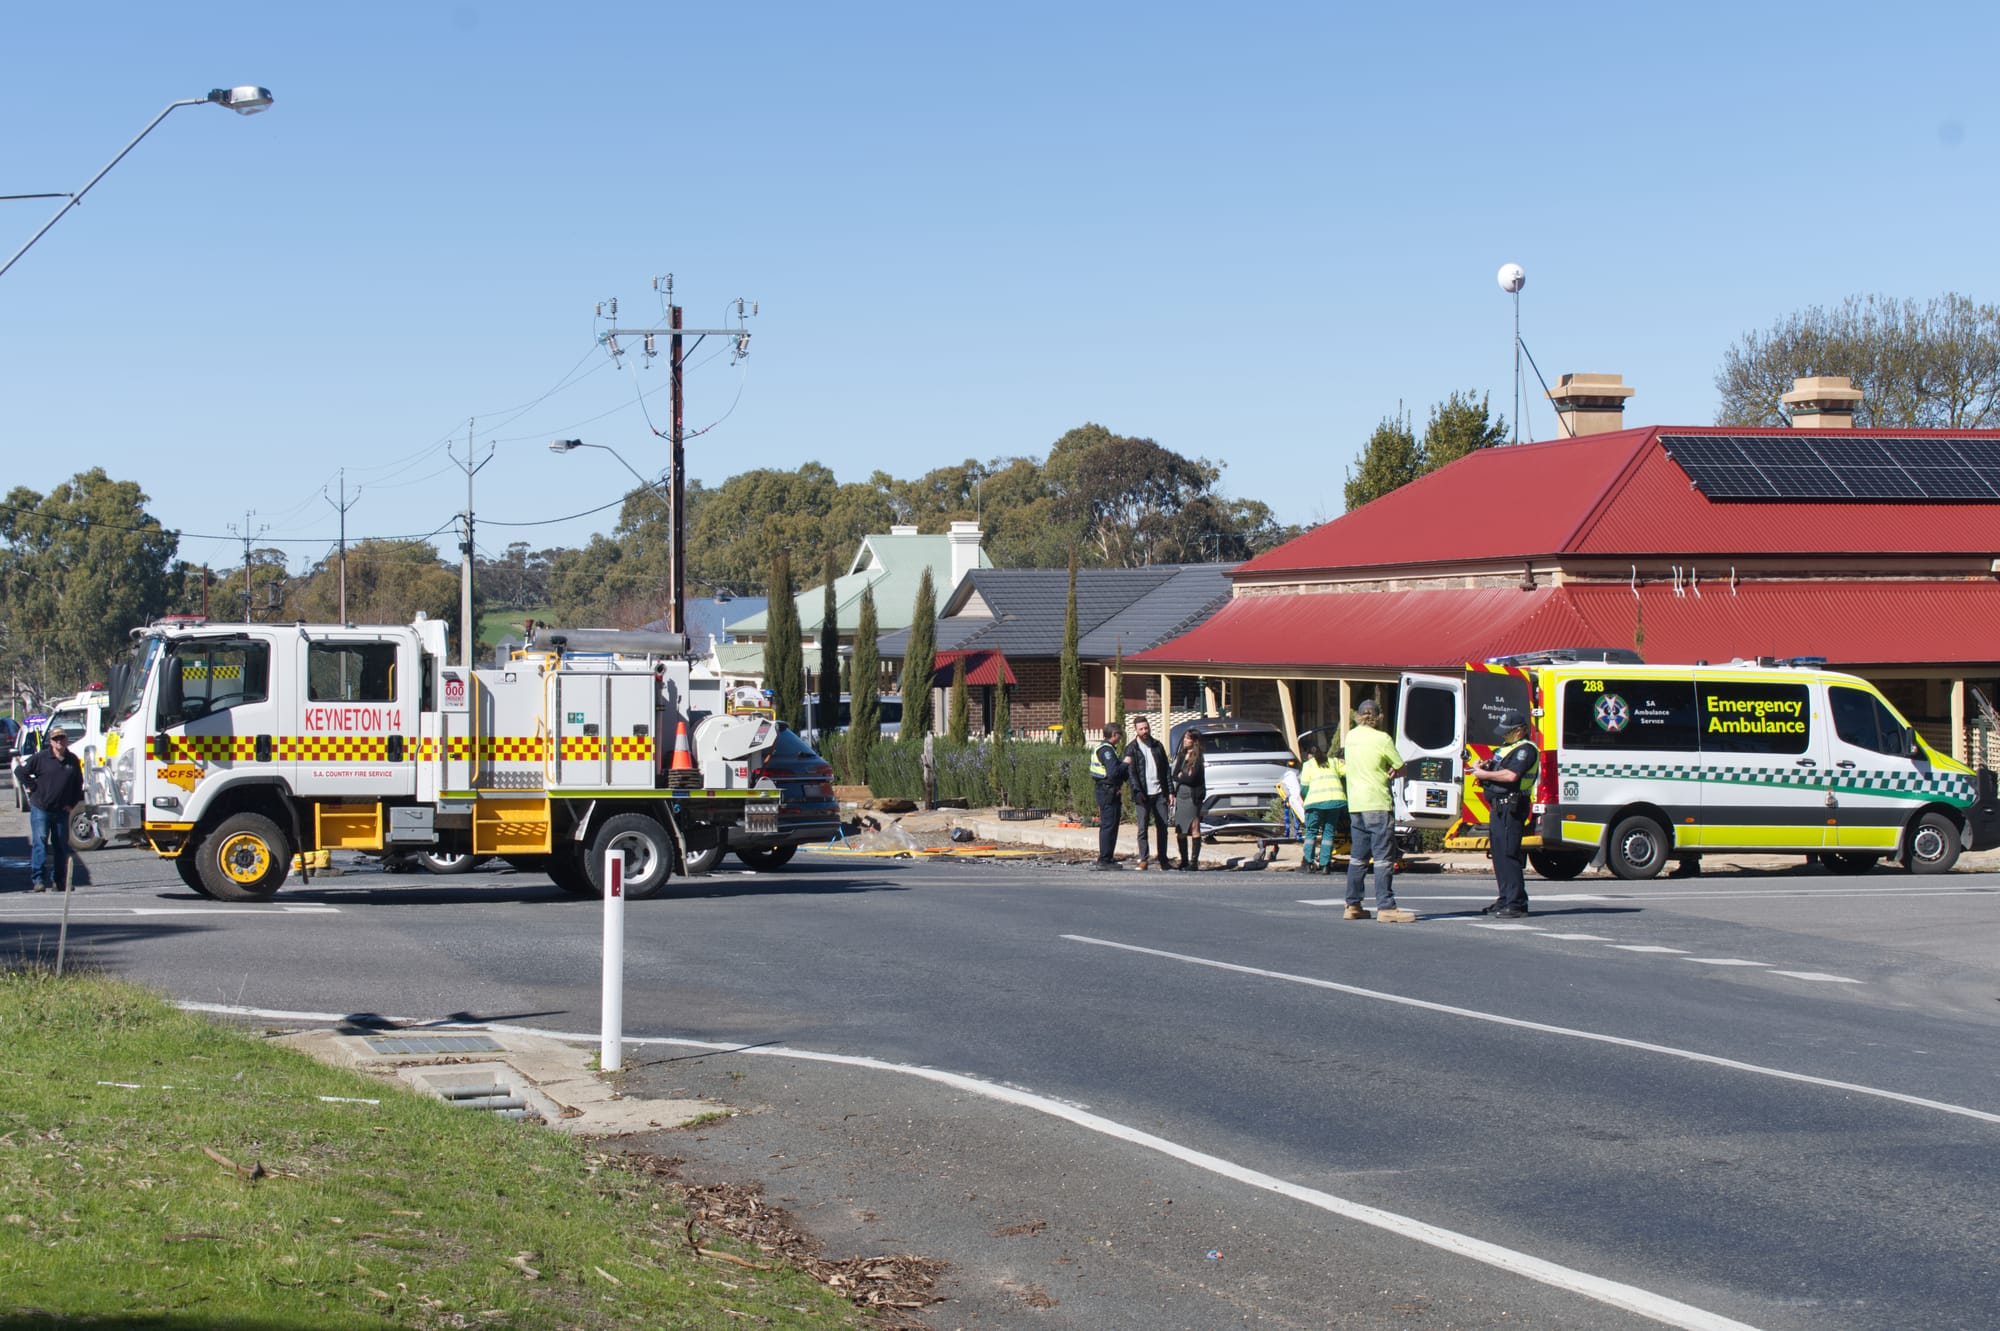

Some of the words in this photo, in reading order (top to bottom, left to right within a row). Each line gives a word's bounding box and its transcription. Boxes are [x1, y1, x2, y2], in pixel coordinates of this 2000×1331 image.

[445, 686, 464, 696] 000
[1583, 681, 1604, 692] 288
[1707, 696, 1803, 717] Emergency
[305, 708, 382, 731] KEYNETON
[386, 708, 401, 731] 14
[1708, 717, 1806, 733] Ambulance
[169, 770, 194, 778] CFS
[1563, 787, 1579, 796] 000
